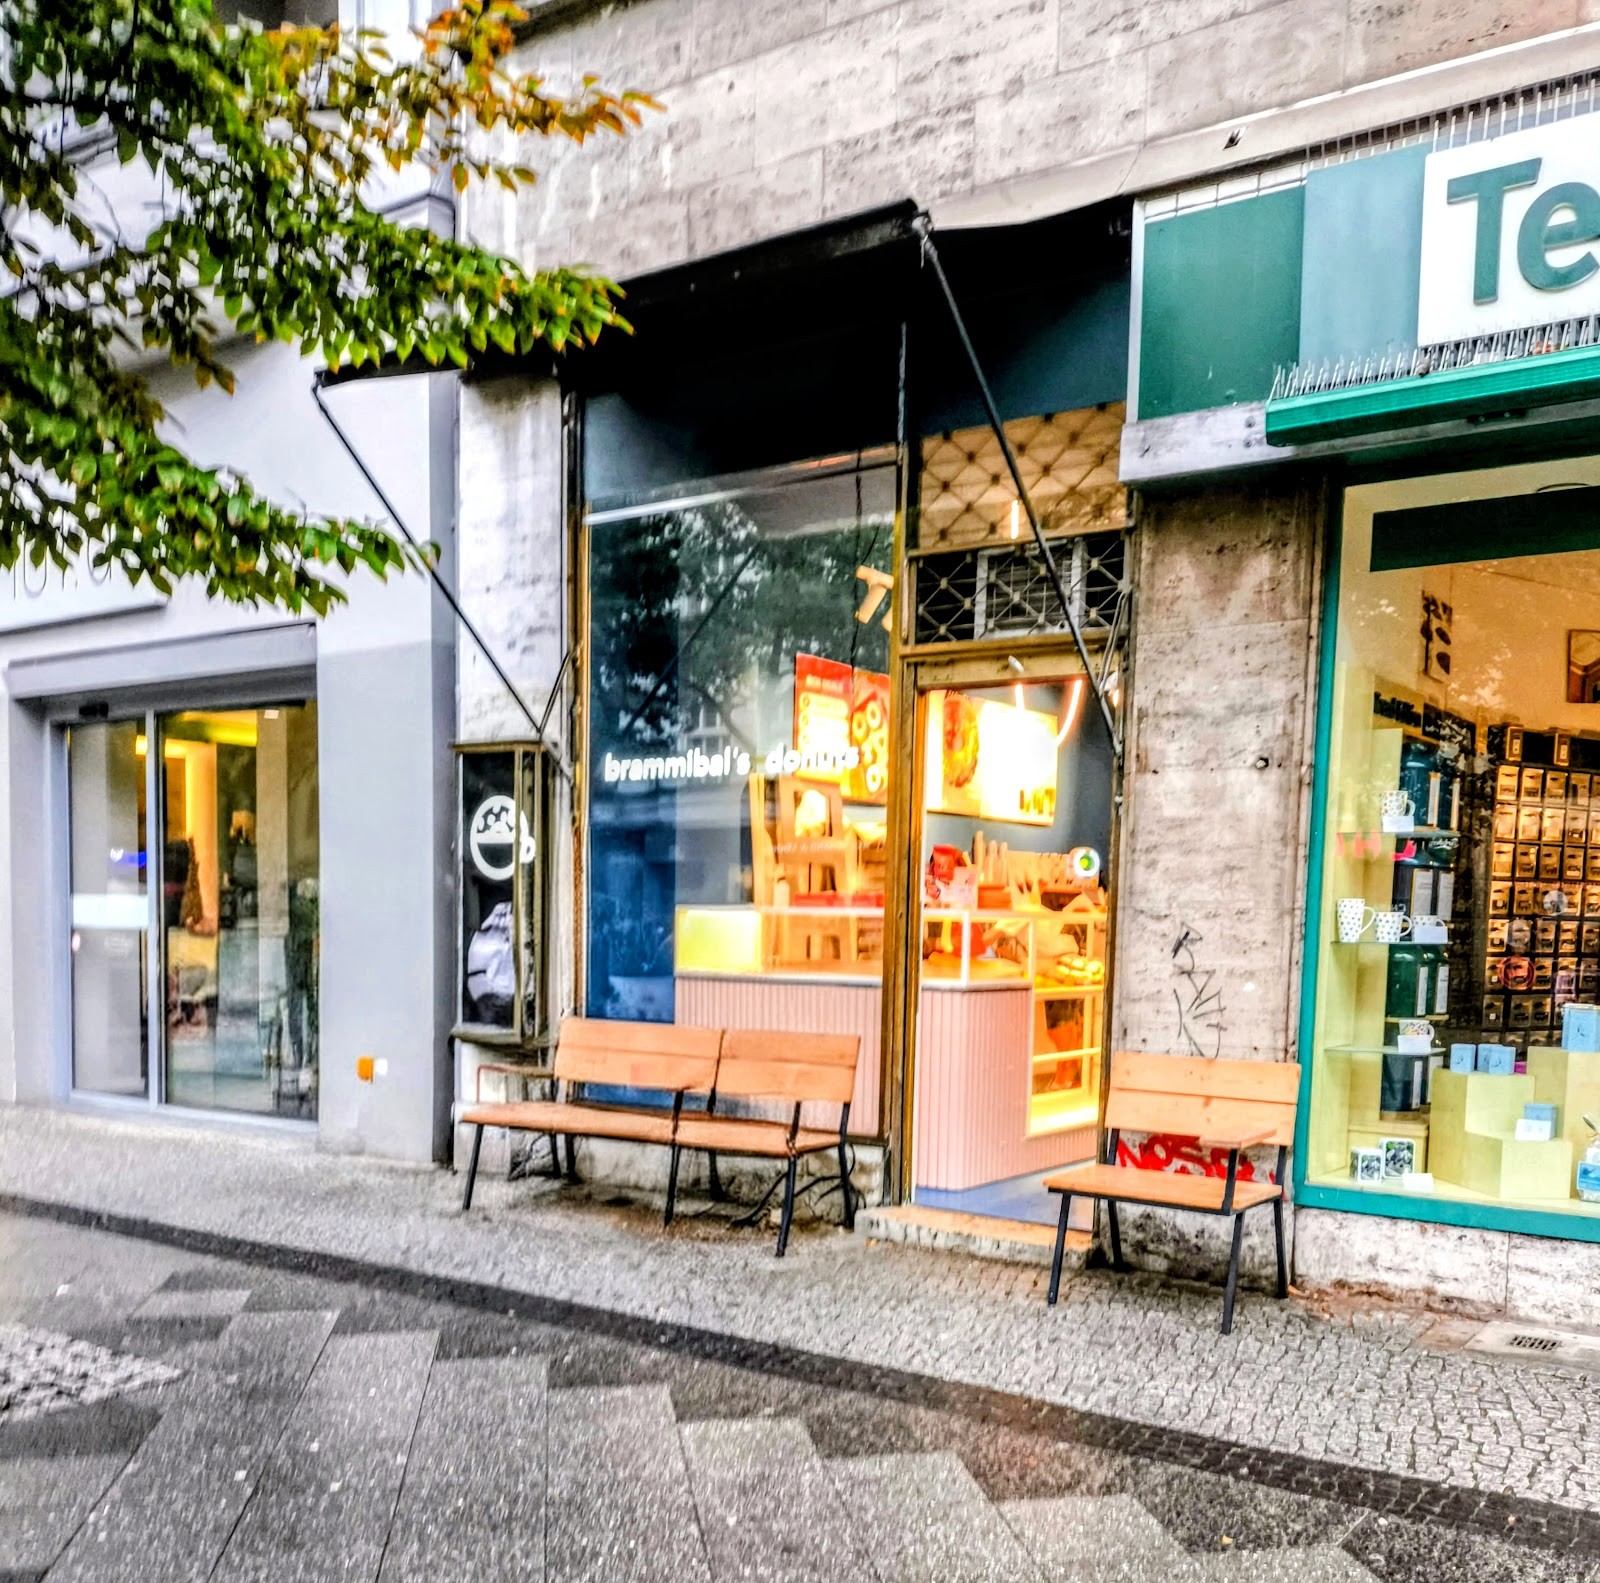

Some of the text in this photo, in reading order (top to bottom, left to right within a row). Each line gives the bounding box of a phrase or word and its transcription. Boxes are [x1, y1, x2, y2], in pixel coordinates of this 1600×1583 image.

[1447, 157, 1600, 306] Te
[604, 742, 859, 782] brammibal's donuts
